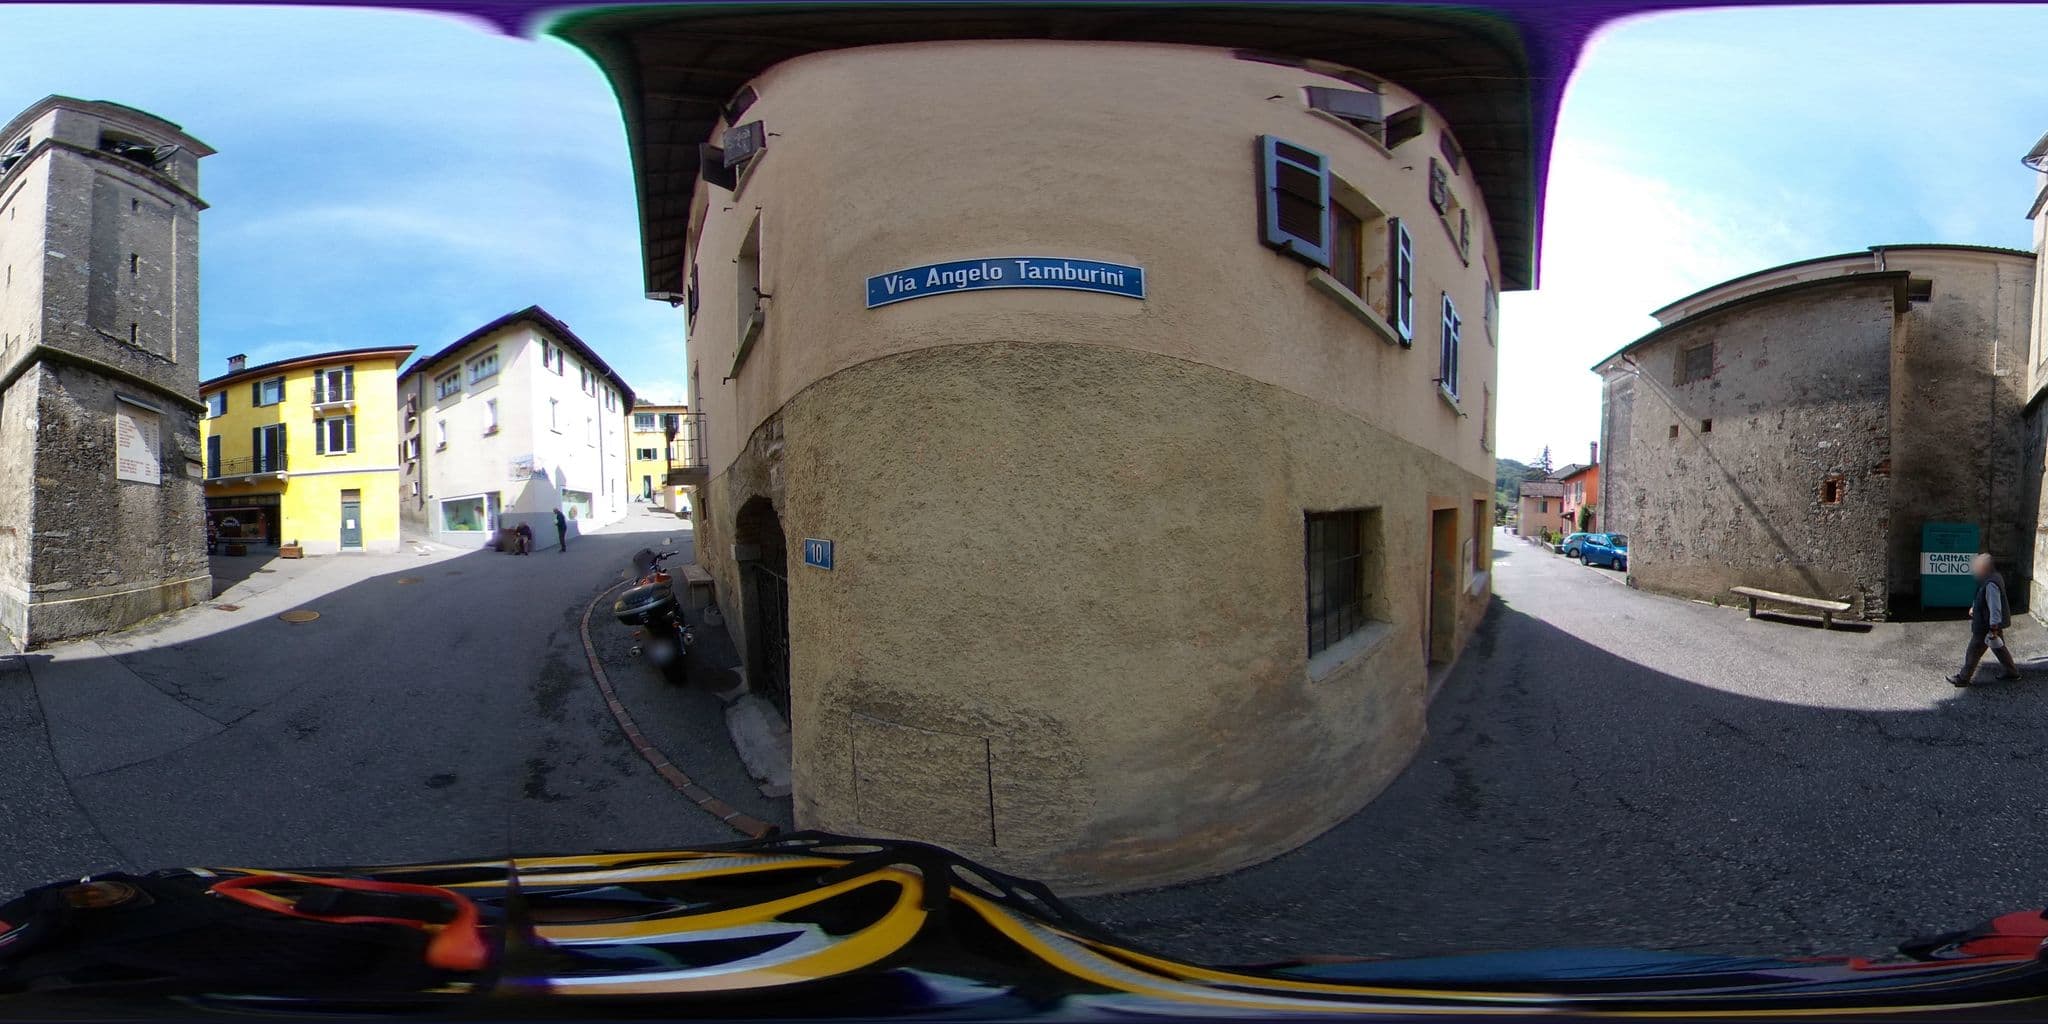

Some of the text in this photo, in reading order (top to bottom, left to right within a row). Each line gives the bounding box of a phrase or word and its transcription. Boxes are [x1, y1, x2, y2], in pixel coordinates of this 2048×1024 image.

[884, 260, 1124, 295] Via Angelo Tamburini
[811, 543, 822, 563] 10
[1930, 562, 1970, 573] TICINO
